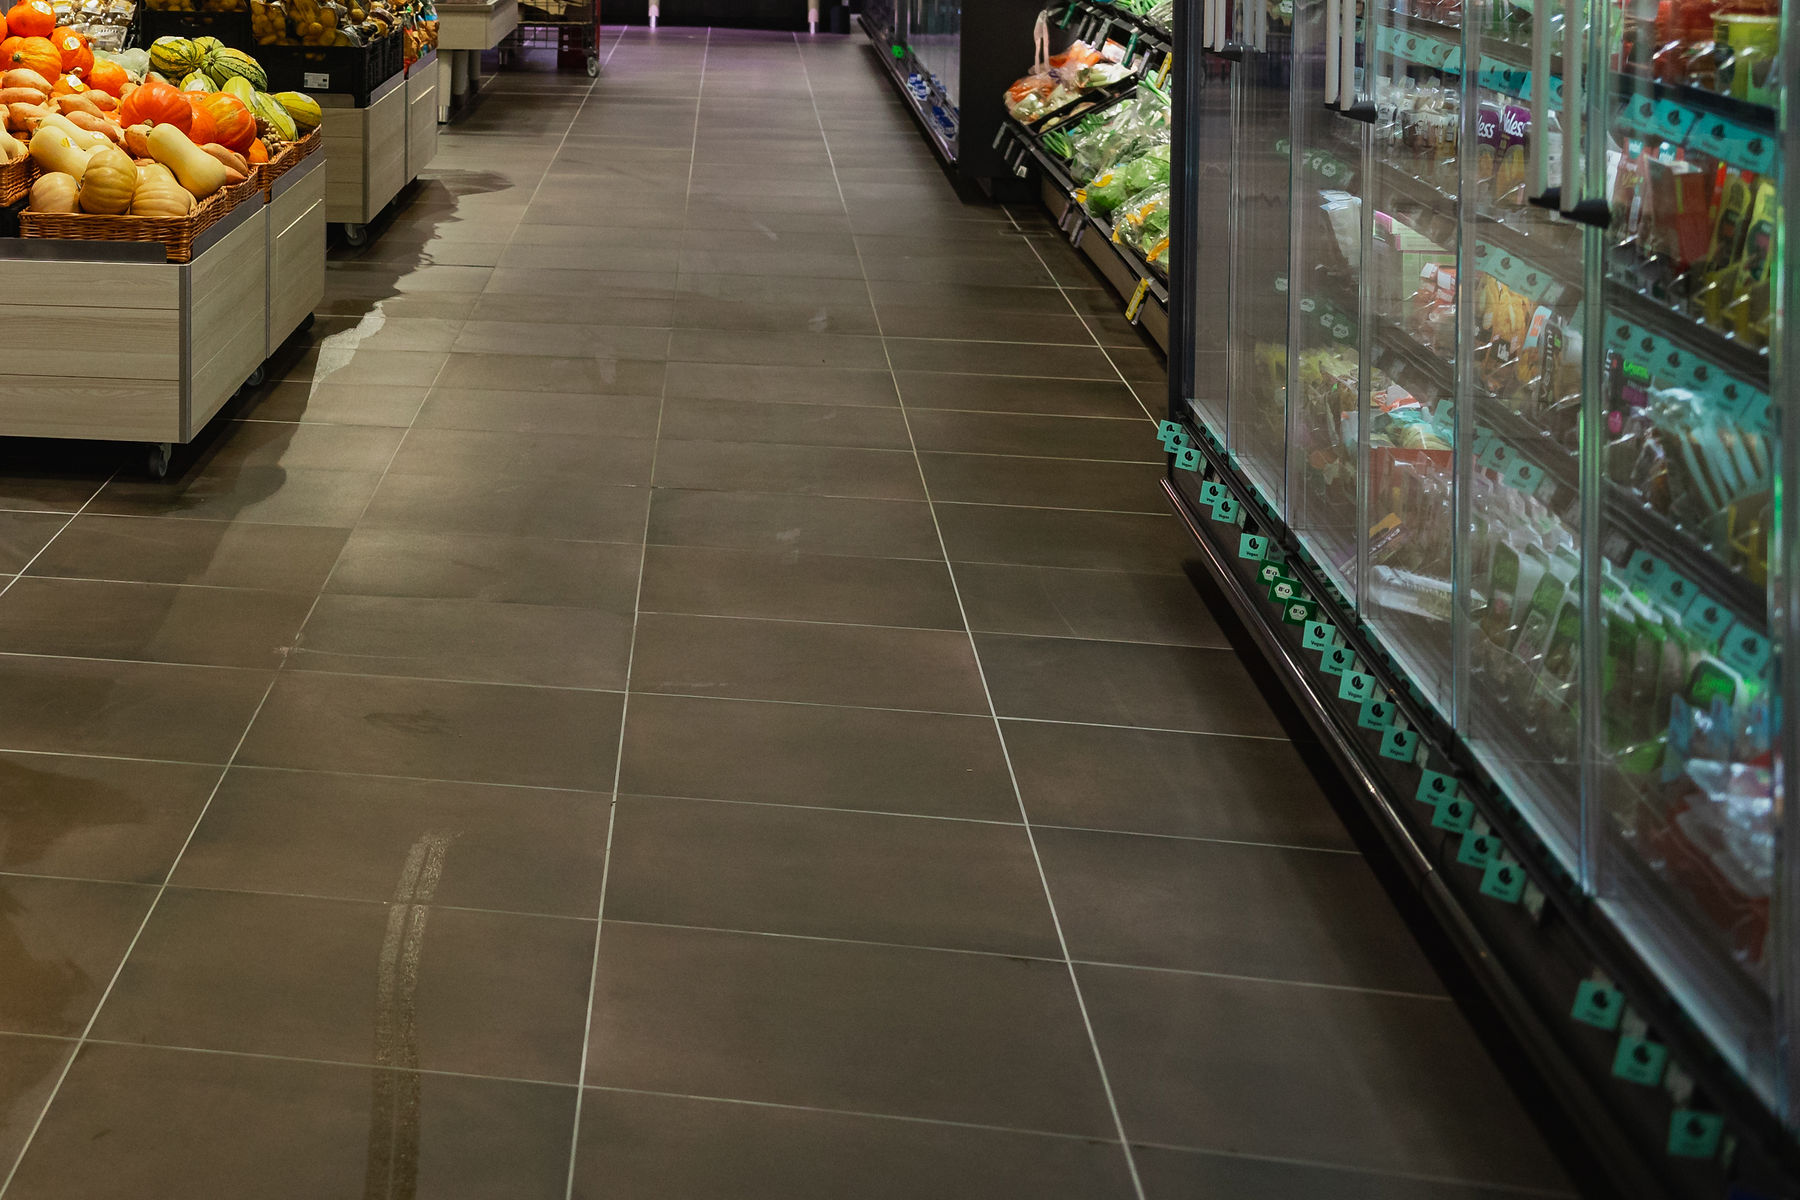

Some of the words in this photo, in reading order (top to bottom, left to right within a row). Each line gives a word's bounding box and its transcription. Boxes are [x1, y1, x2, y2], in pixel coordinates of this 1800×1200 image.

[1278, 586, 1290, 594] BIO
[1293, 608, 1305, 616] BIO
[1311, 640, 1325, 648] Vegan
[1347, 691, 1363, 699] Vegan
[1367, 719, 1383, 727] Vegan
